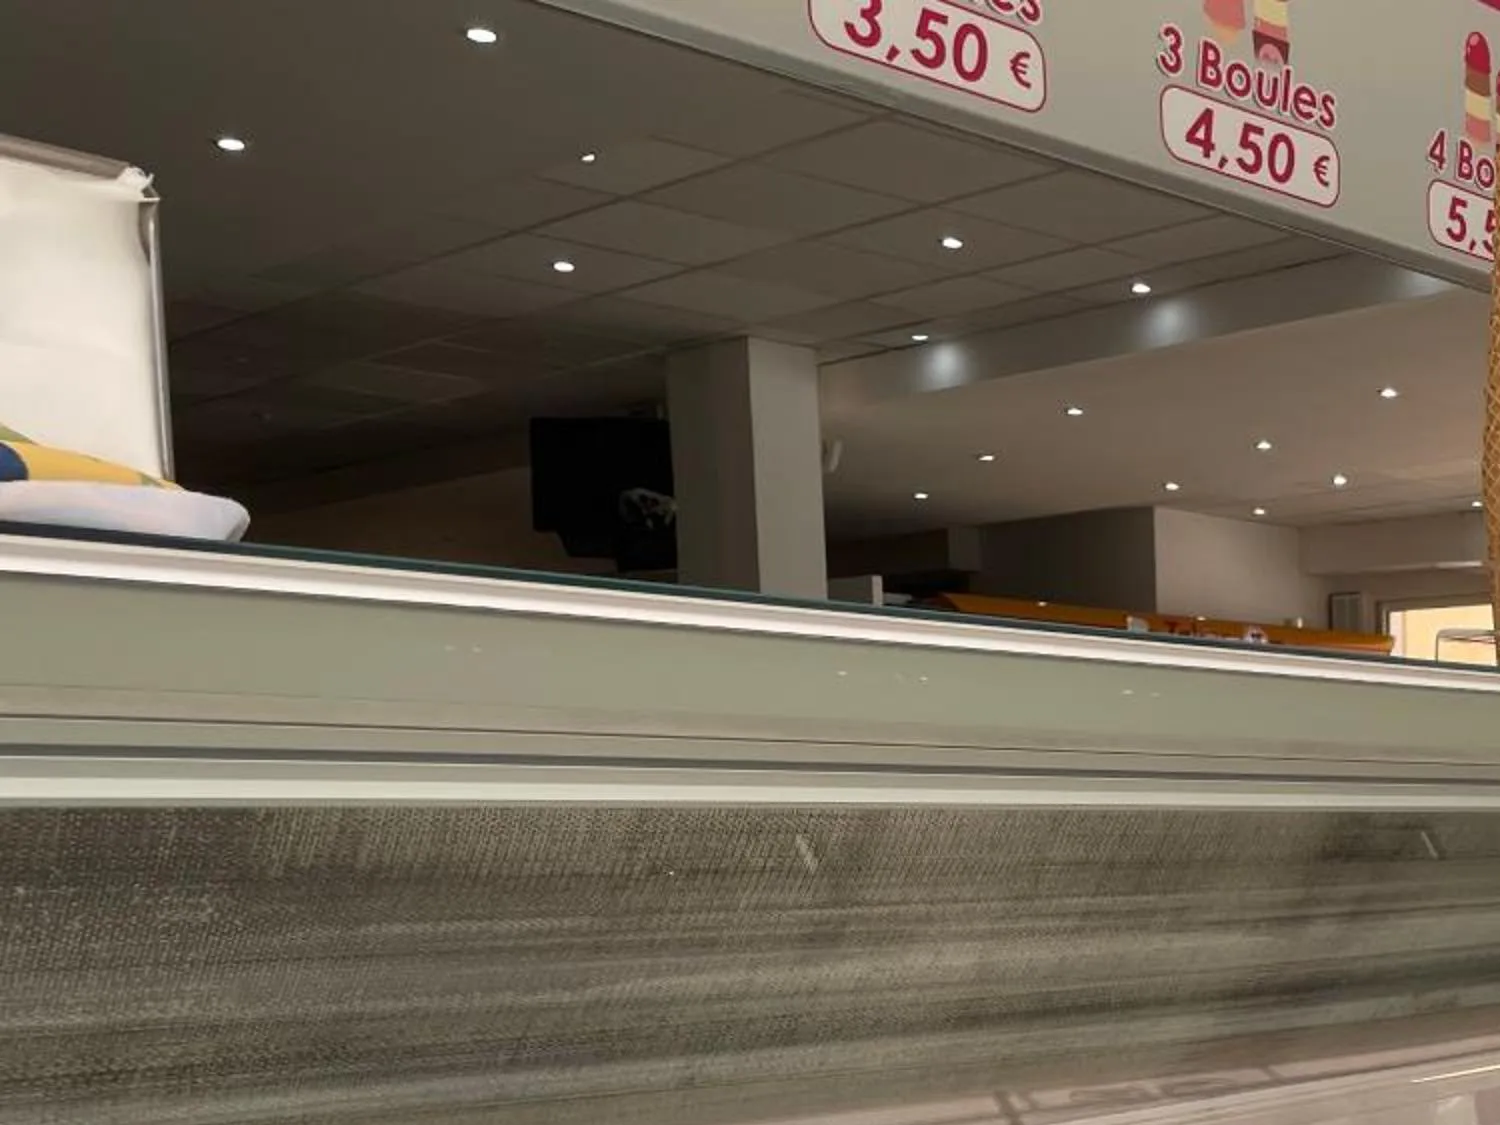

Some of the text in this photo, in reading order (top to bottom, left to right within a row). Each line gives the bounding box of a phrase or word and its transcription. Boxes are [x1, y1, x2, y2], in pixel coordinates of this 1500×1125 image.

[843, 0, 1032, 89] 3,50 €
[1159, 25, 1337, 129] 3 Boules
[1184, 106, 1332, 188] 4,50 €
[1428, 130, 1447, 171] 4
